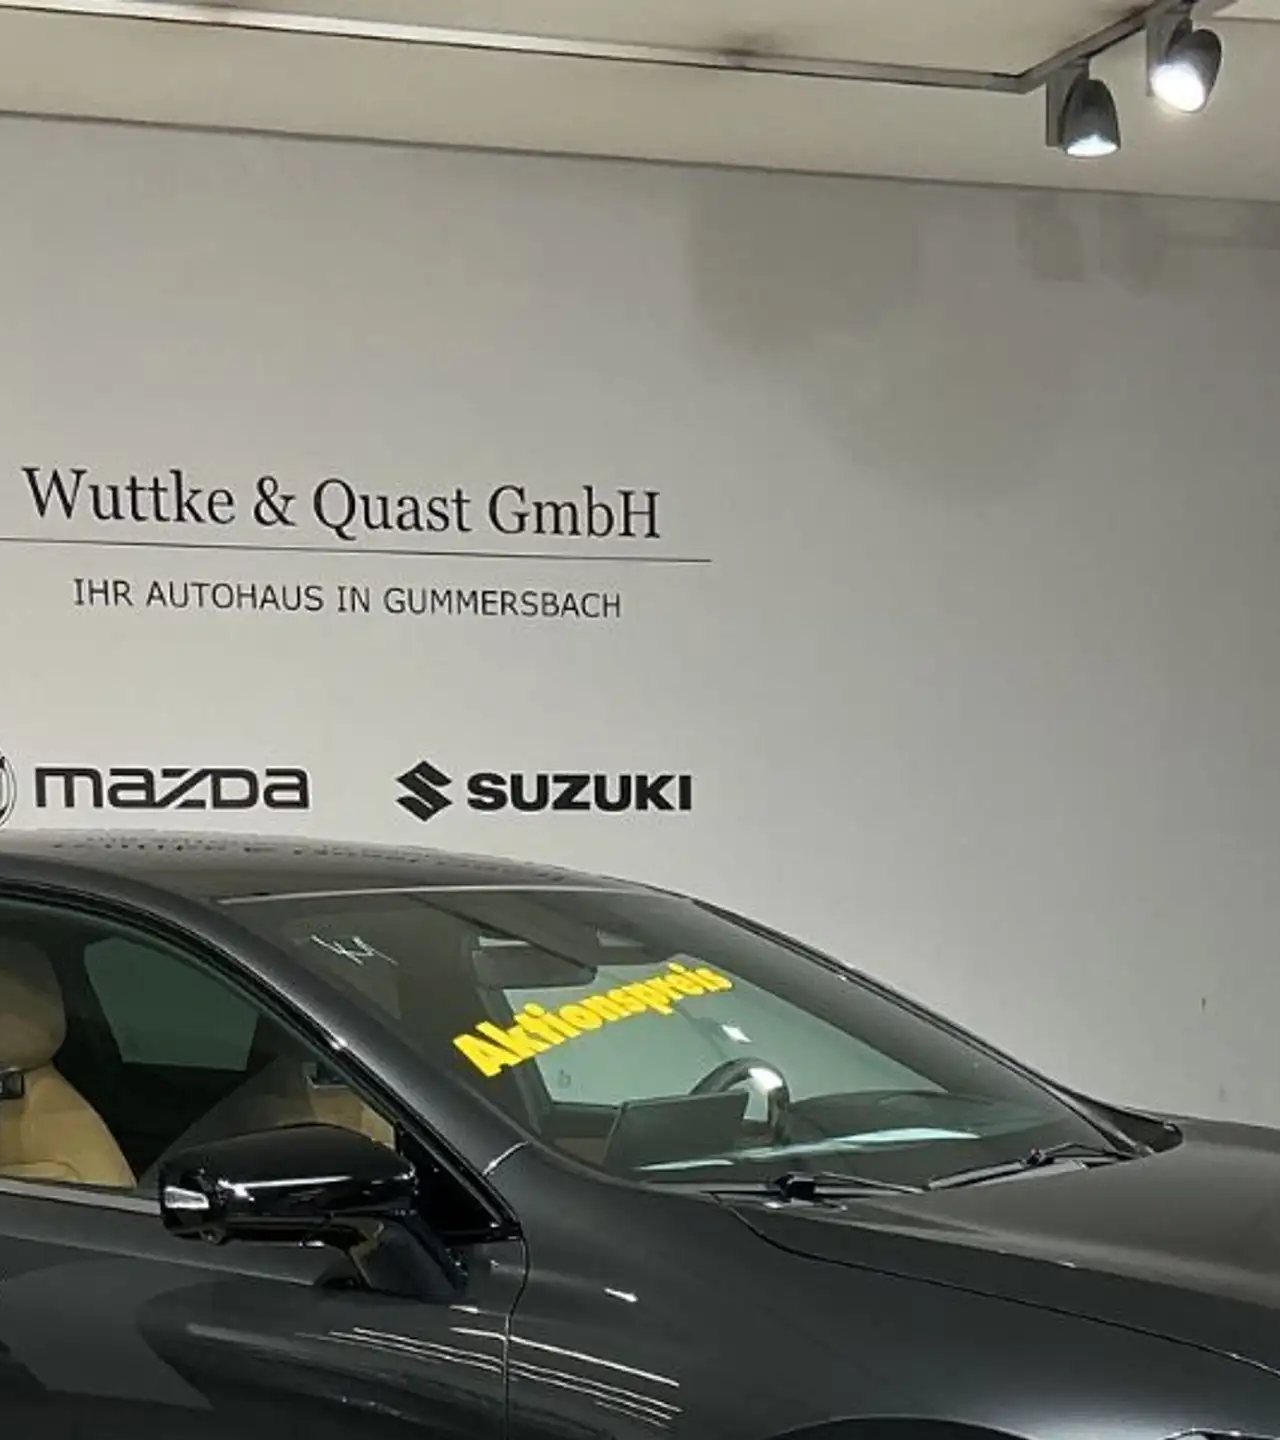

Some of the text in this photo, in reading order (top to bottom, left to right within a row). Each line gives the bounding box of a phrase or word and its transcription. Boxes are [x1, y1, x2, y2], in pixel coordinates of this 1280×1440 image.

[22, 467, 660, 541] Wuttke & Quast GmbH
[74, 578, 621, 618] IHR AUTOHAUS IN GUMMERSBACH
[467, 772, 692, 812] SUZUKI
[453, 962, 732, 1077] Aktionspreis
